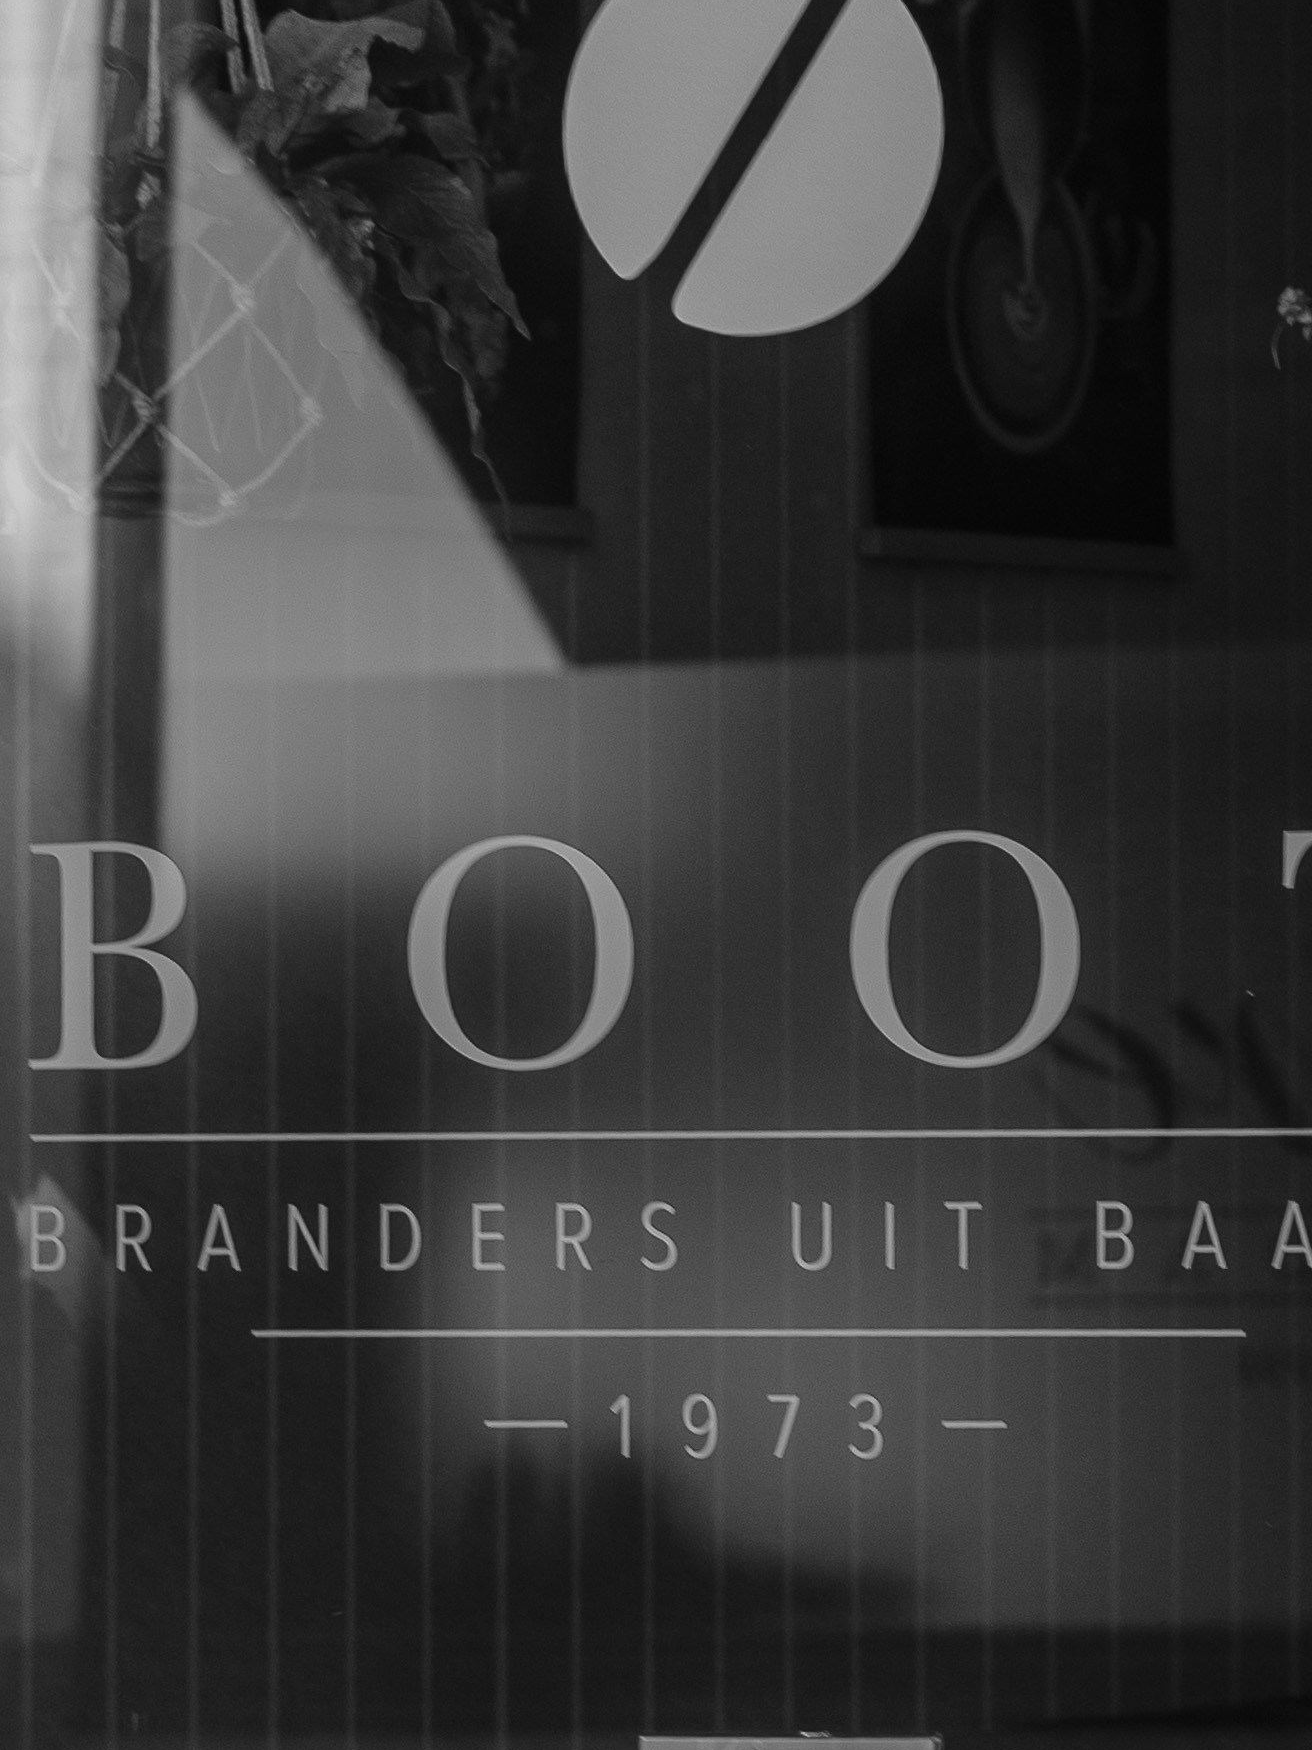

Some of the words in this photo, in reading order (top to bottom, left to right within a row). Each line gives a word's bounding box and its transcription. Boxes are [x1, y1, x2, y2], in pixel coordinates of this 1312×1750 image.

[29, 1200, 680, 1274] BRANDERS
[788, 1199, 985, 1271] UIT
[609, 1393, 887, 1461] 1973
